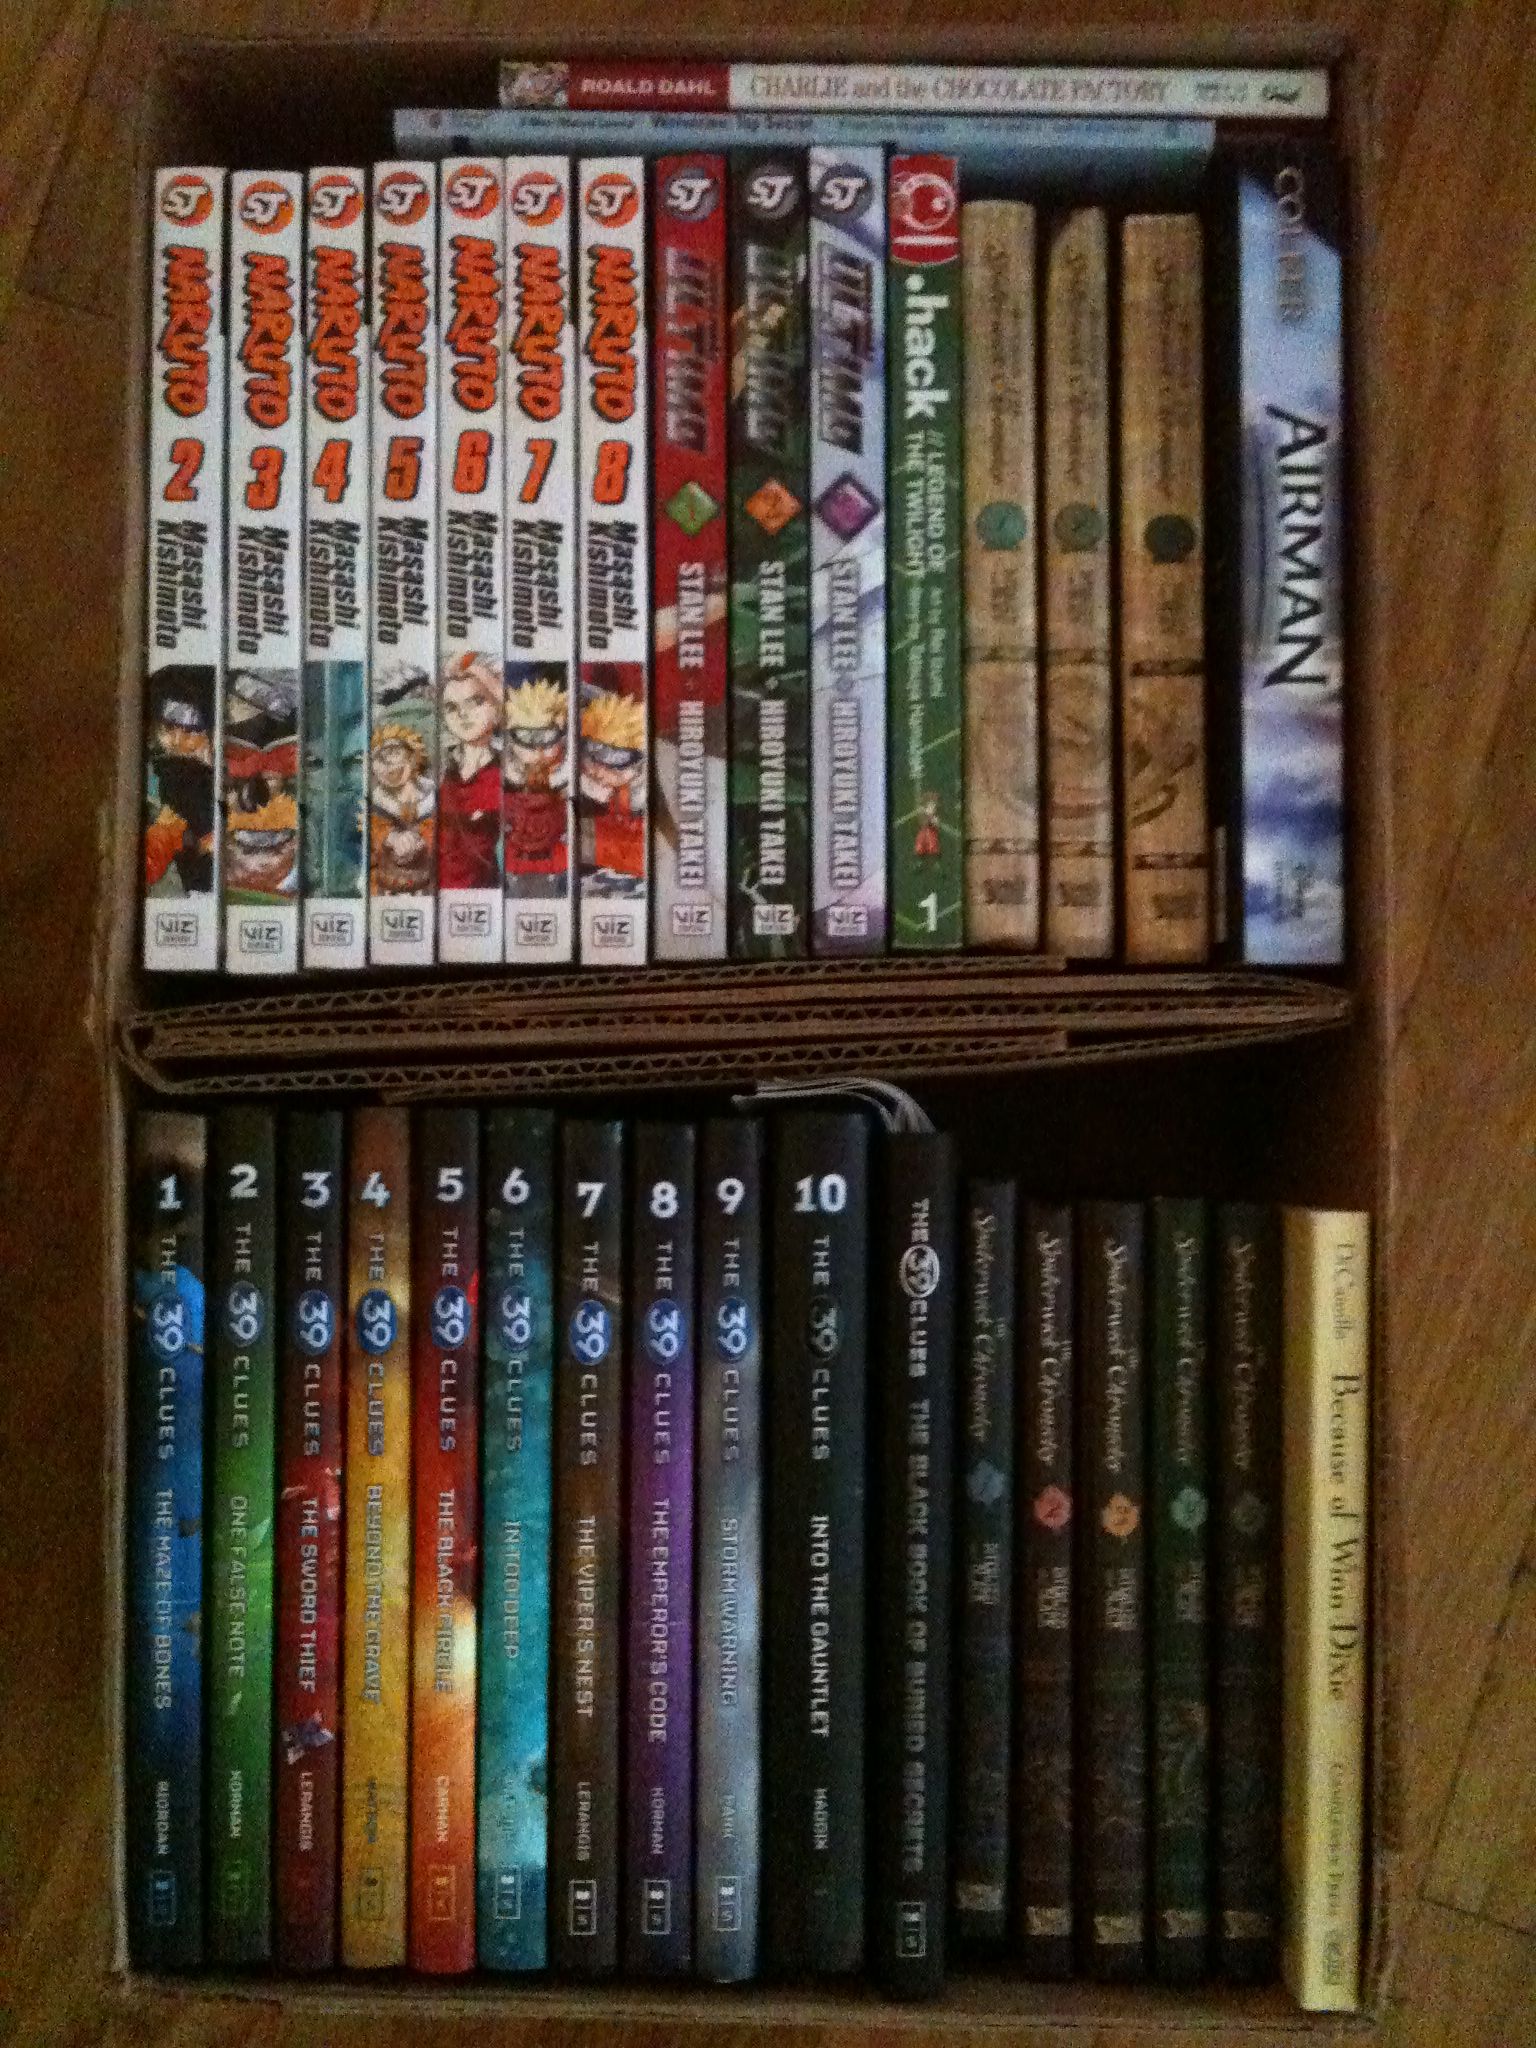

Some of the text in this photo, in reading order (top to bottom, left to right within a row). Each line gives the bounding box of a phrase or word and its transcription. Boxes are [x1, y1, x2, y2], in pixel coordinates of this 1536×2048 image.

[581, 78, 715, 96] ROALD DAHL
[750, 76, 848, 97] CHARLIE
[853, 76, 891, 98] and
[932, 77, 1069, 102] CHOCOLATE
[1071, 79, 1168, 103] FACTORY
[157, 246, 213, 502] NARUTO 2
[237, 252, 295, 511] NARUTO 3
[307, 247, 363, 504] NARUTO 4
[375, 242, 430, 502] NARUTO 5
[445, 236, 501, 495] NARUTO 6
[510, 243, 565, 504] NARUTO 7
[583, 245, 640, 505] NARUTO 8
[904, 273, 950, 419] .hack
[905, 431, 925, 578] THE TWILIGHT
[927, 544, 945, 571] OF
[1261, 405, 1330, 689] AIRMAN
[155, 520, 181, 649] Kishimoto
[181, 521, 207, 630] Masashi
[237, 526, 264, 654] Kishimoto
[263, 527, 290, 636] Masashi
[309, 520, 335, 648] Kishimoto
[334, 520, 361, 628] Masashi
[377, 517, 404, 645] Kishimoto
[403, 518, 429, 627] Masashi
[446, 511, 474, 639] Kishimoto
[472, 511, 499, 619] Masashi
[510, 520, 538, 649] Kishimoto
[537, 521, 563, 628] Masashi
[586, 521, 614, 650] Kishimoto
[614, 521, 638, 630] Masashi
[678, 562, 704, 887] STAN LEE HIROYUKI TAKEI
[760, 561, 785, 884] STAN LEE HIROYUKI TAKEI
[831, 560, 861, 888] STAN LEE HIROYUKI TAKEI
[919, 892, 937, 932] 1
[158, 1176, 181, 1211] 1
[229, 1163, 258, 1199] 2
[300, 1172, 331, 1208] 3
[360, 1172, 391, 1208] 4
[435, 1167, 463, 1202] 5
[502, 1167, 530, 1205] 6
[577, 1181, 605, 1219] 7
[650, 1181, 679, 1219] 8
[717, 1178, 746, 1215] 9
[793, 1173, 849, 1214] 10
[911, 1198, 929, 1243] THE
[153, 1235, 182, 1460] THE 39 CLUES
[230, 1223, 257, 1448] THE 39 CLUES
[301, 1231, 328, 1456] THE 39 CLUES
[362, 1231, 390, 1456] THE 39 CLUES
[435, 1227, 464, 1452] THE 39 CLUES
[502, 1227, 531, 1452] THE 39 CLUES
[575, 1241, 604, 1465] THE 39 CLUES
[650, 1240, 679, 1464] THE 39 CLUES
[718, 1238, 746, 1462] THE 39 CLUES
[809, 1236, 837, 1460] THE 39 CLUES
[908, 1299, 928, 1378] CLUES
[908, 1399, 929, 1444] THE
[1330, 1373, 1361, 1484] Because
[155, 1536, 172, 1590] MAZE
[156, 1490, 172, 1529] THE
[439, 1489, 457, 1531] THE
[577, 1516, 595, 1557] THE
[1329, 1496, 1360, 1522] of
[299, 1497, 318, 1694] THE SWORD THIEF
[364, 1581, 380, 1621] THE
[437, 1536, 455, 1608] BLACK
[648, 1498, 670, 1743] THE EMPEROR'S CODE
[720, 1518, 739, 1705] STORM WARNING
[809, 1515, 830, 1737] INTO THE GAUNTLET
[153, 1635, 171, 1709] BONES
[229, 1621, 245, 1677] NOTE
[503, 1601, 519, 1659] DEEP
[576, 1660, 593, 1717] NEST
